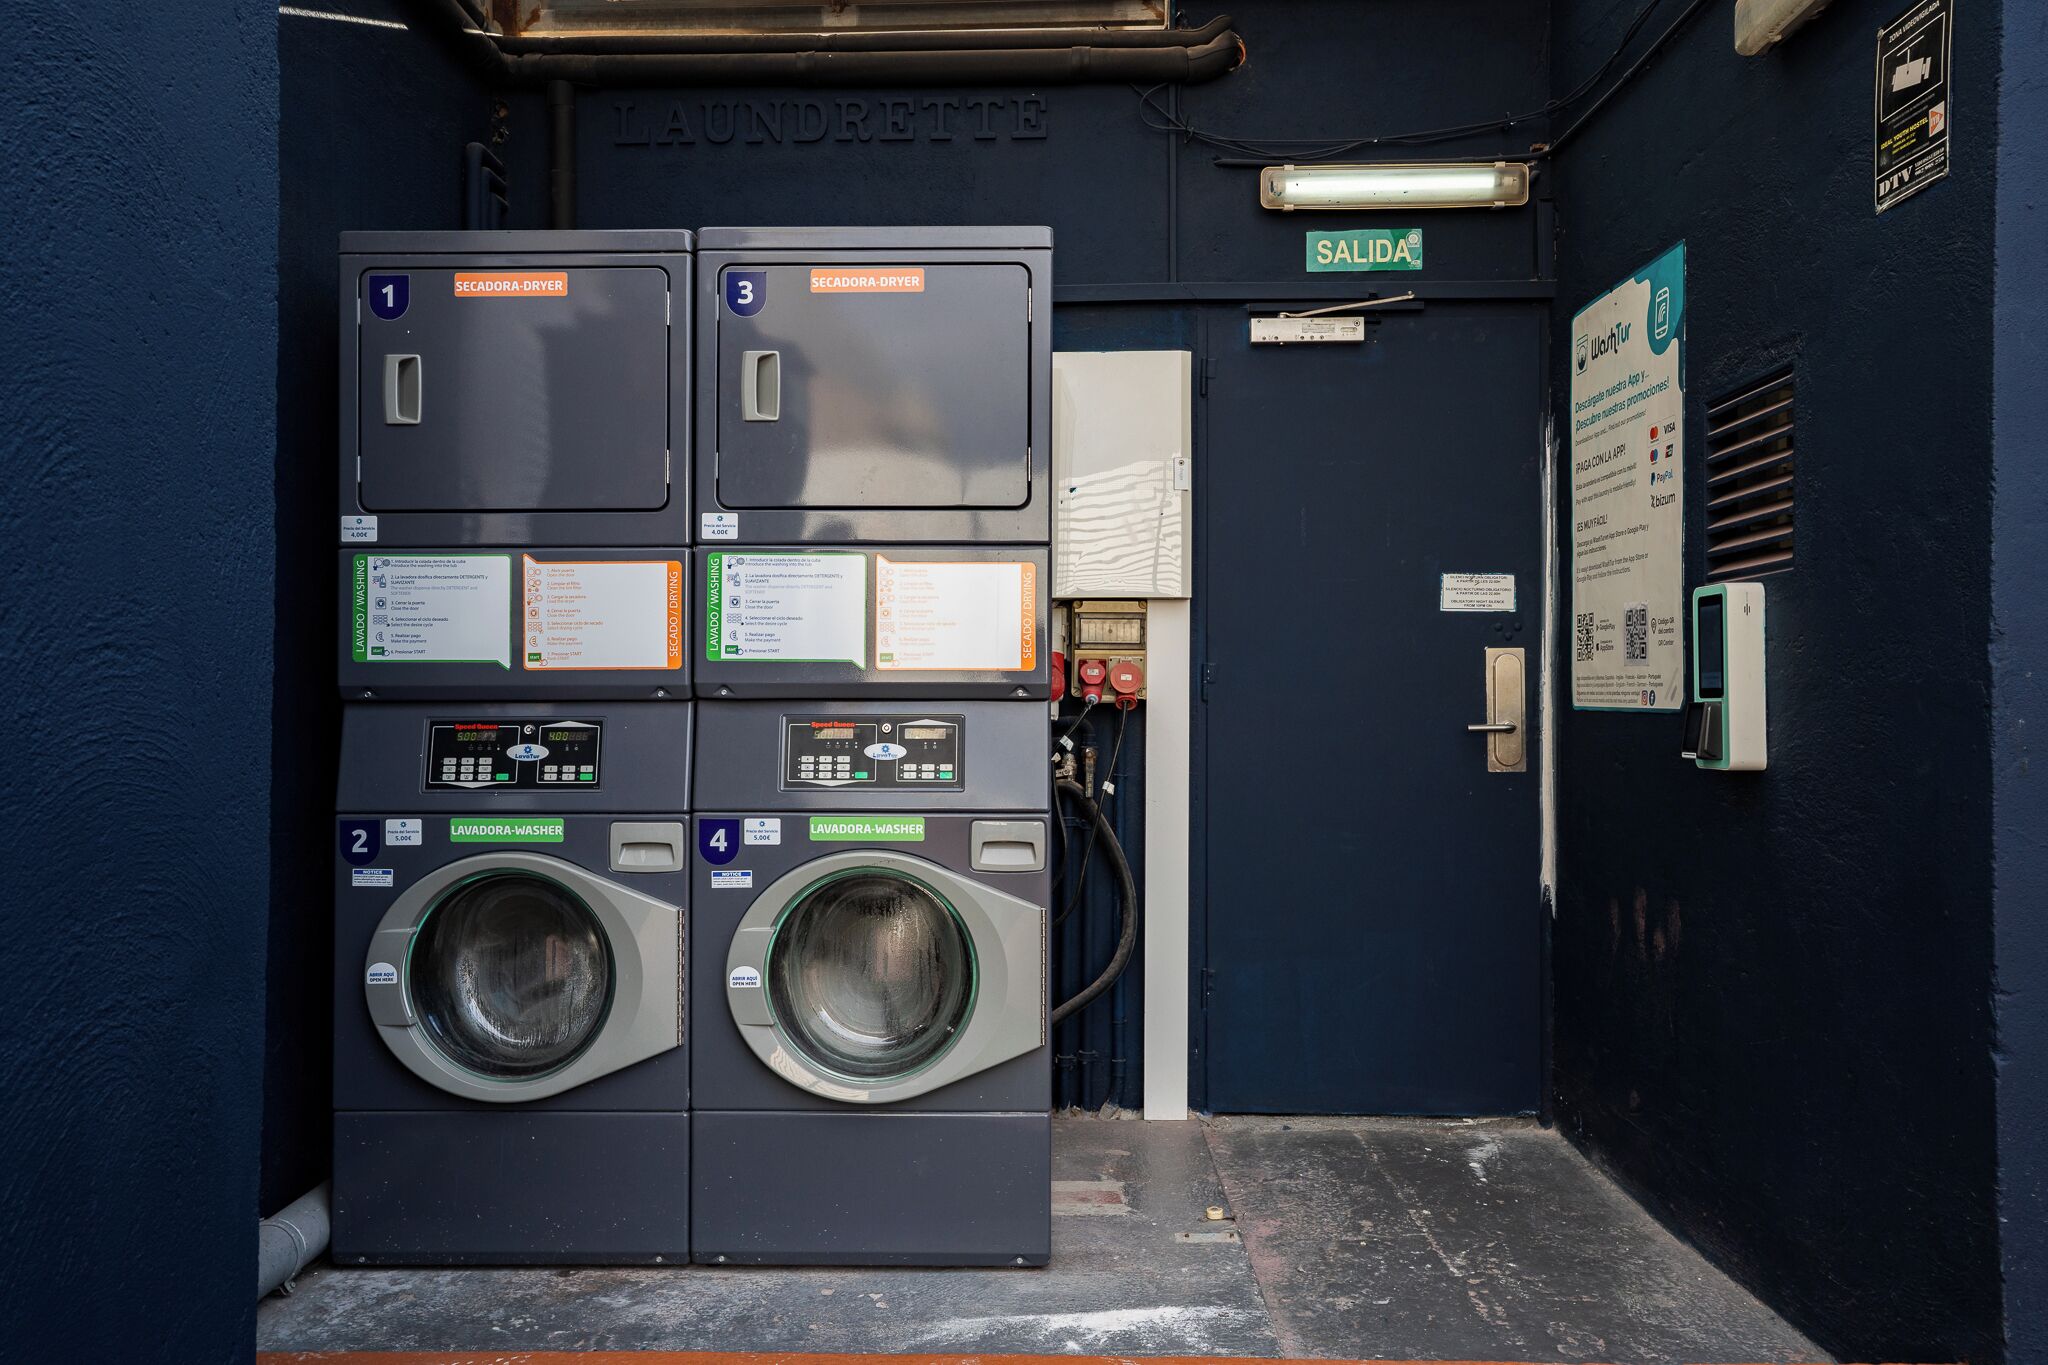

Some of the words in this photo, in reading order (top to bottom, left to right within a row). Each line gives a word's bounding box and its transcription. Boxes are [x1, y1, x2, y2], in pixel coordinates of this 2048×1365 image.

[614, 95, 1049, 146] LAUNDRETTE
[1879, 165, 1913, 197] DTV
[1316, 238, 1412, 264] SALIDA
[455, 279, 563, 292] SECADORA-DRYER
[737, 280, 754, 304] 3
[812, 275, 920, 288] SECADORA-DRYER
[381, 284, 394, 307] 1
[1591, 321, 1631, 360] WashTur
[1605, 380, 1627, 399] nuestra
[1627, 374, 1640, 387] App
[1663, 422, 1676, 435] VISA
[1592, 453, 1604, 468] CON
[1604, 450, 1611, 463] LA
[1656, 469, 1673, 483] PayPal
[1655, 493, 1676, 508] bizum
[356, 559, 365, 606] WASHING
[670, 571, 678, 609] DRYING
[711, 558, 719, 604] WASHING
[1023, 572, 1032, 610] DRYING
[356, 613, 365, 653] LAVADO
[669, 616, 678, 657] SECADO
[710, 612, 719, 651] LAVADO
[1022, 618, 1032, 658] SECADO
[351, 829, 368, 853] 2
[451, 825, 563, 836] LAVADORA-WASHER
[710, 828, 728, 852] 4
[811, 823, 924, 834] LAVADORA-WASHER
